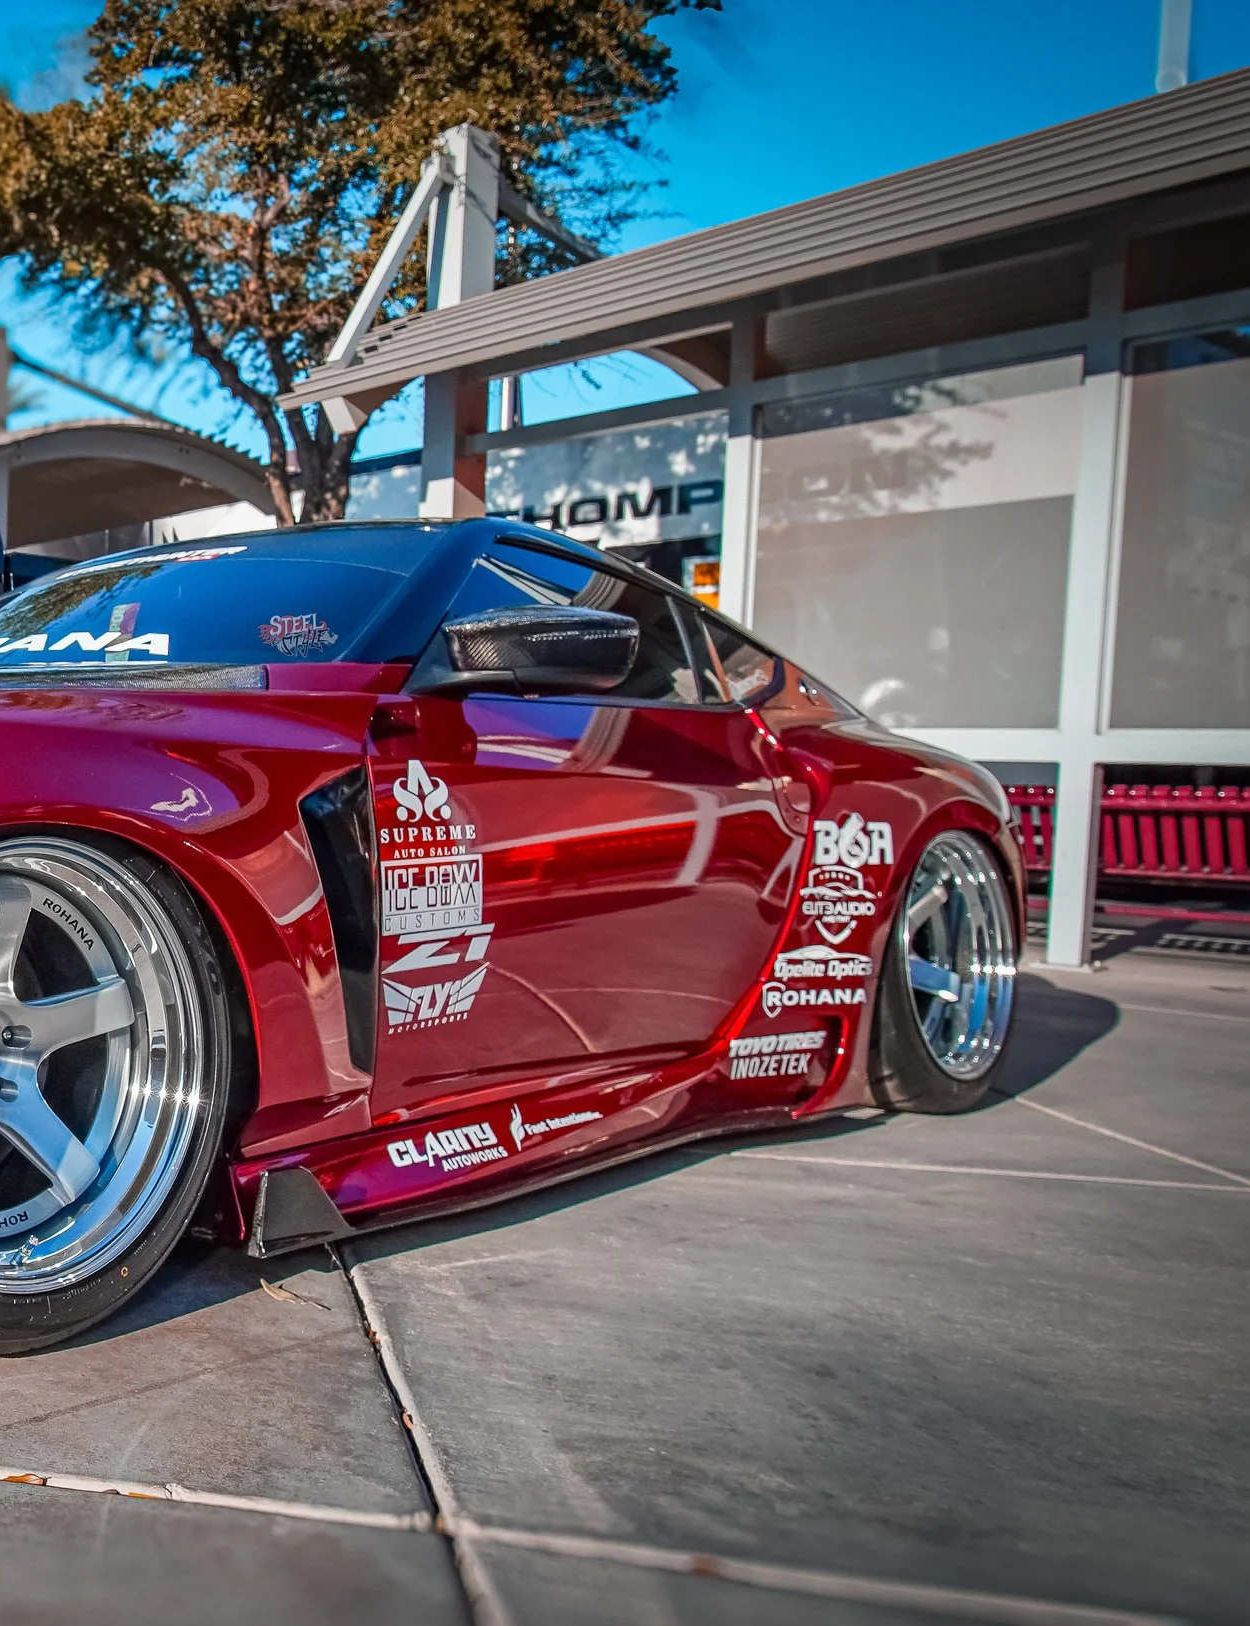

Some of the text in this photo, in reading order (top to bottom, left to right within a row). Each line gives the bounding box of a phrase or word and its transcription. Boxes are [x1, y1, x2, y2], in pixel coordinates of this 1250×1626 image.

[269, 612, 325, 637] STEEL
[380, 824, 477, 844] SUPREME
[393, 845, 466, 859] AUTO SALON
[42, 897, 95, 951] ROHANA
[384, 908, 481, 931] CUSTOMS
[765, 987, 868, 1009] ROHANA
[728, 1035, 777, 1058] TOYO
[730, 1052, 812, 1080] INOZETEK
[386, 1121, 498, 1168] CLARITY
[441, 1146, 509, 1172] AUTOWORKS
